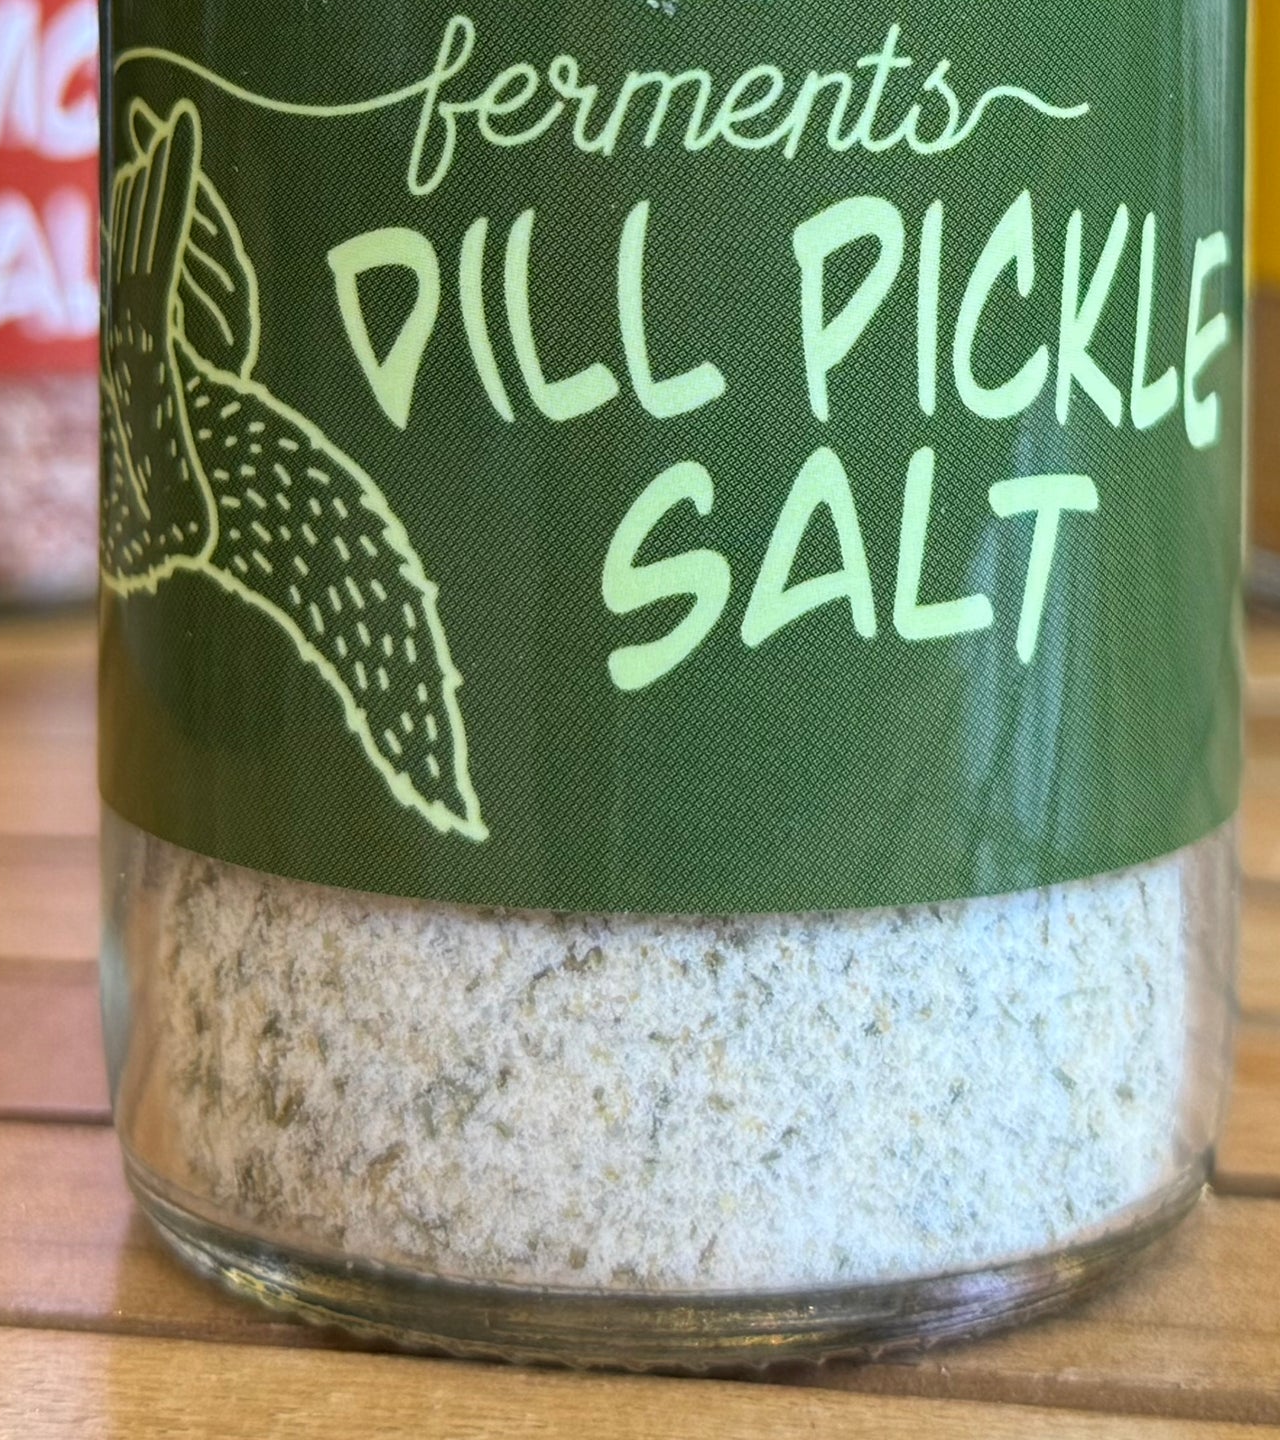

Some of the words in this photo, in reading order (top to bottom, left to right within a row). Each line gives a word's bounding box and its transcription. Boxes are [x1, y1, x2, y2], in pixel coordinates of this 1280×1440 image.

[407, 15, 1089, 197] ferments
[327, 199, 726, 430] DILL
[791, 188, 1231, 448] PICKLE
[601, 446, 1099, 691] SALT
